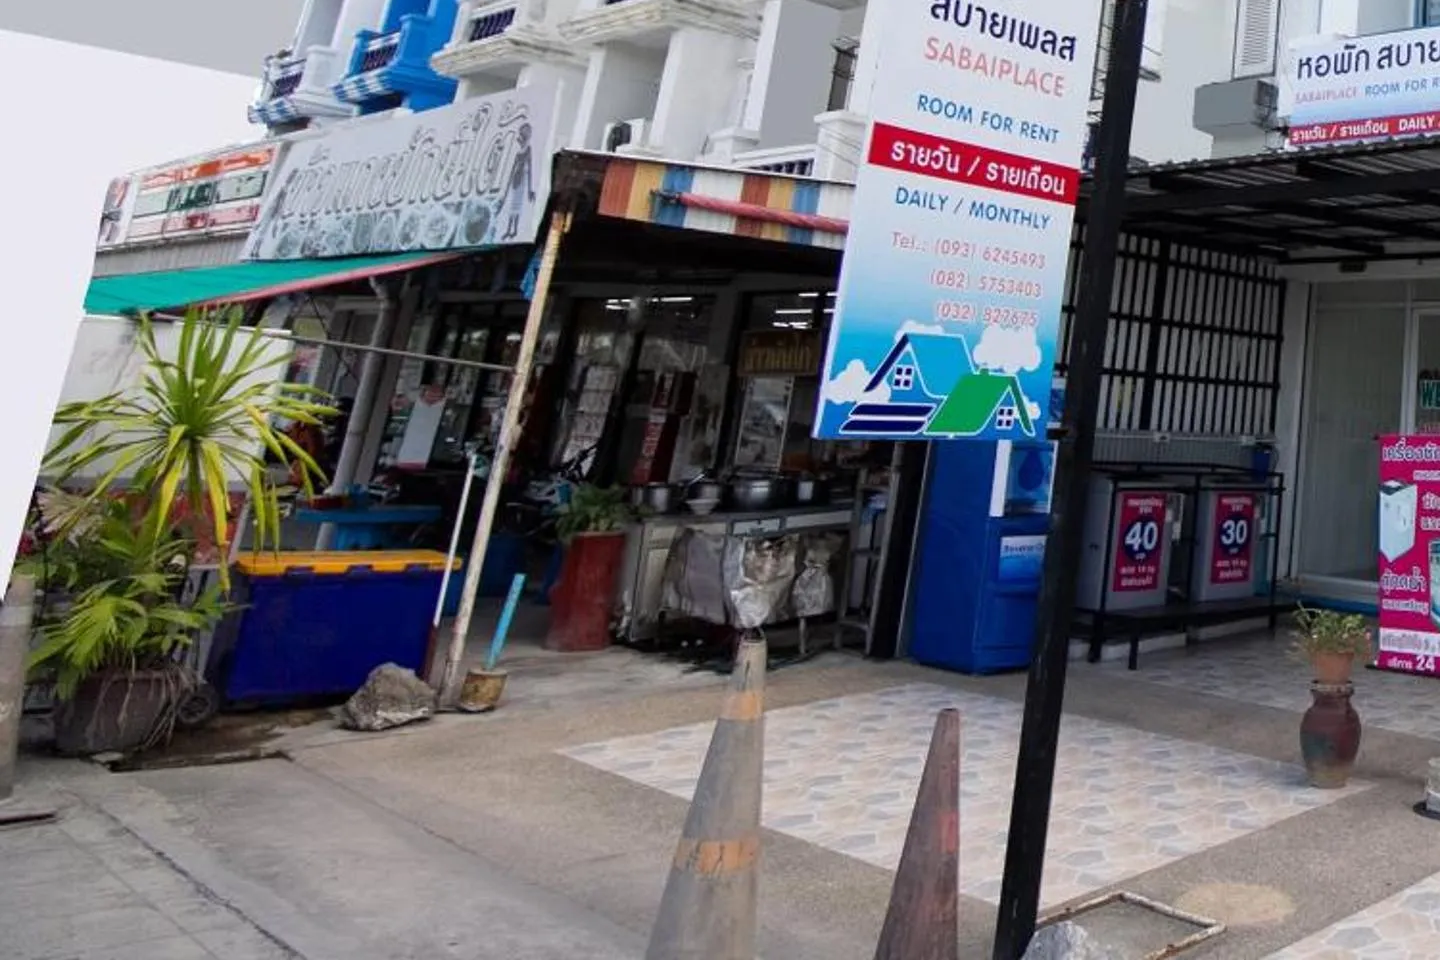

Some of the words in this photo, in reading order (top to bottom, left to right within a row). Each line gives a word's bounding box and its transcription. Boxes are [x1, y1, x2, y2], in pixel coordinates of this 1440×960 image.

[923, 37, 1066, 98] SABAIPLACE
[1297, 44, 1371, 81] หอพัก
[1365, 83, 1400, 97] ROOM
[1405, 77, 1428, 92] FOR
[915, 93, 974, 123] ROOM
[979, 108, 1014, 134] FOR
[1019, 117, 1060, 145] RENT
[1399, 115, 1435, 133] DAILY
[890, 139, 962, 177] รายวัน
[985, 155, 1066, 197] รายเดือน
[894, 186, 949, 214] DAILY
[968, 199, 1052, 231] MONTHLY
[1124, 520, 1159, 552] 40
[1220, 519, 1248, 546] 30
[1415, 653, 1436, 672] 24
